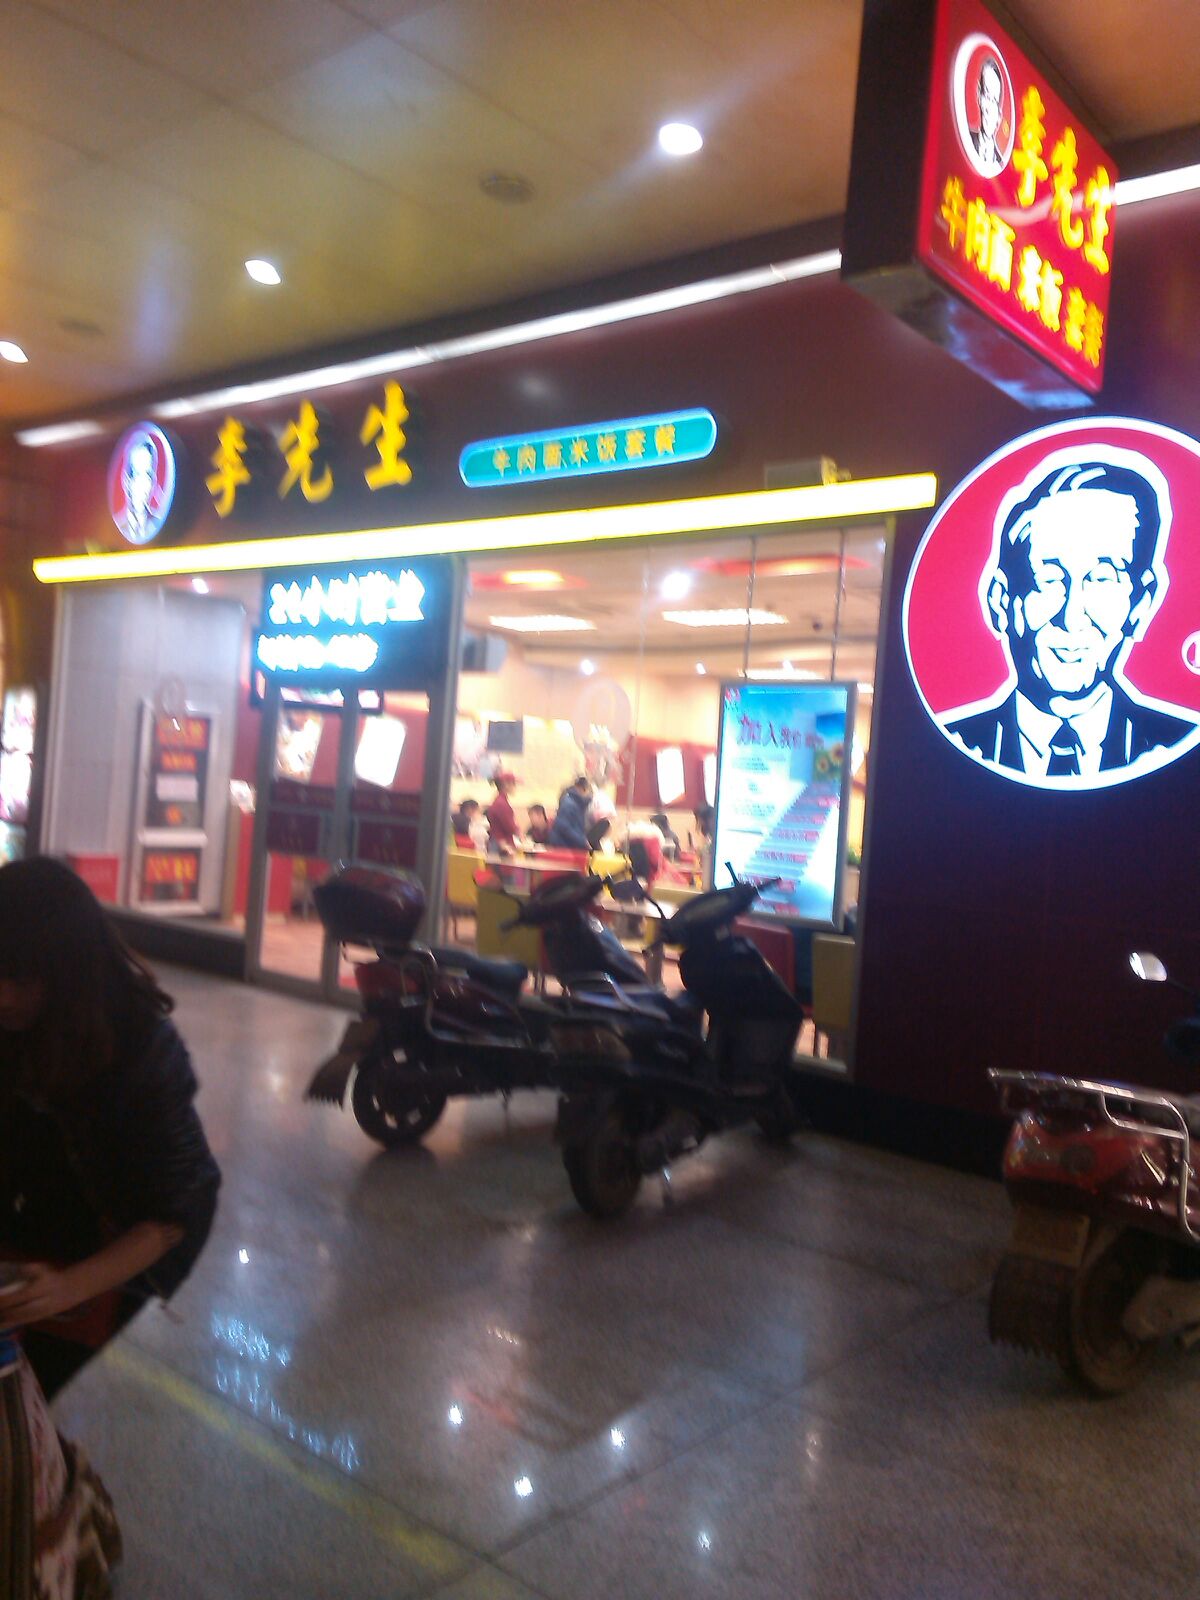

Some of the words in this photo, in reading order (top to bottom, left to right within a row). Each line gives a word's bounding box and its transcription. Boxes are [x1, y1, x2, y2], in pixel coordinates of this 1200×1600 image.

[1013, 84, 1111, 276] 李先生
[205, 379, 413, 518] 李先生
